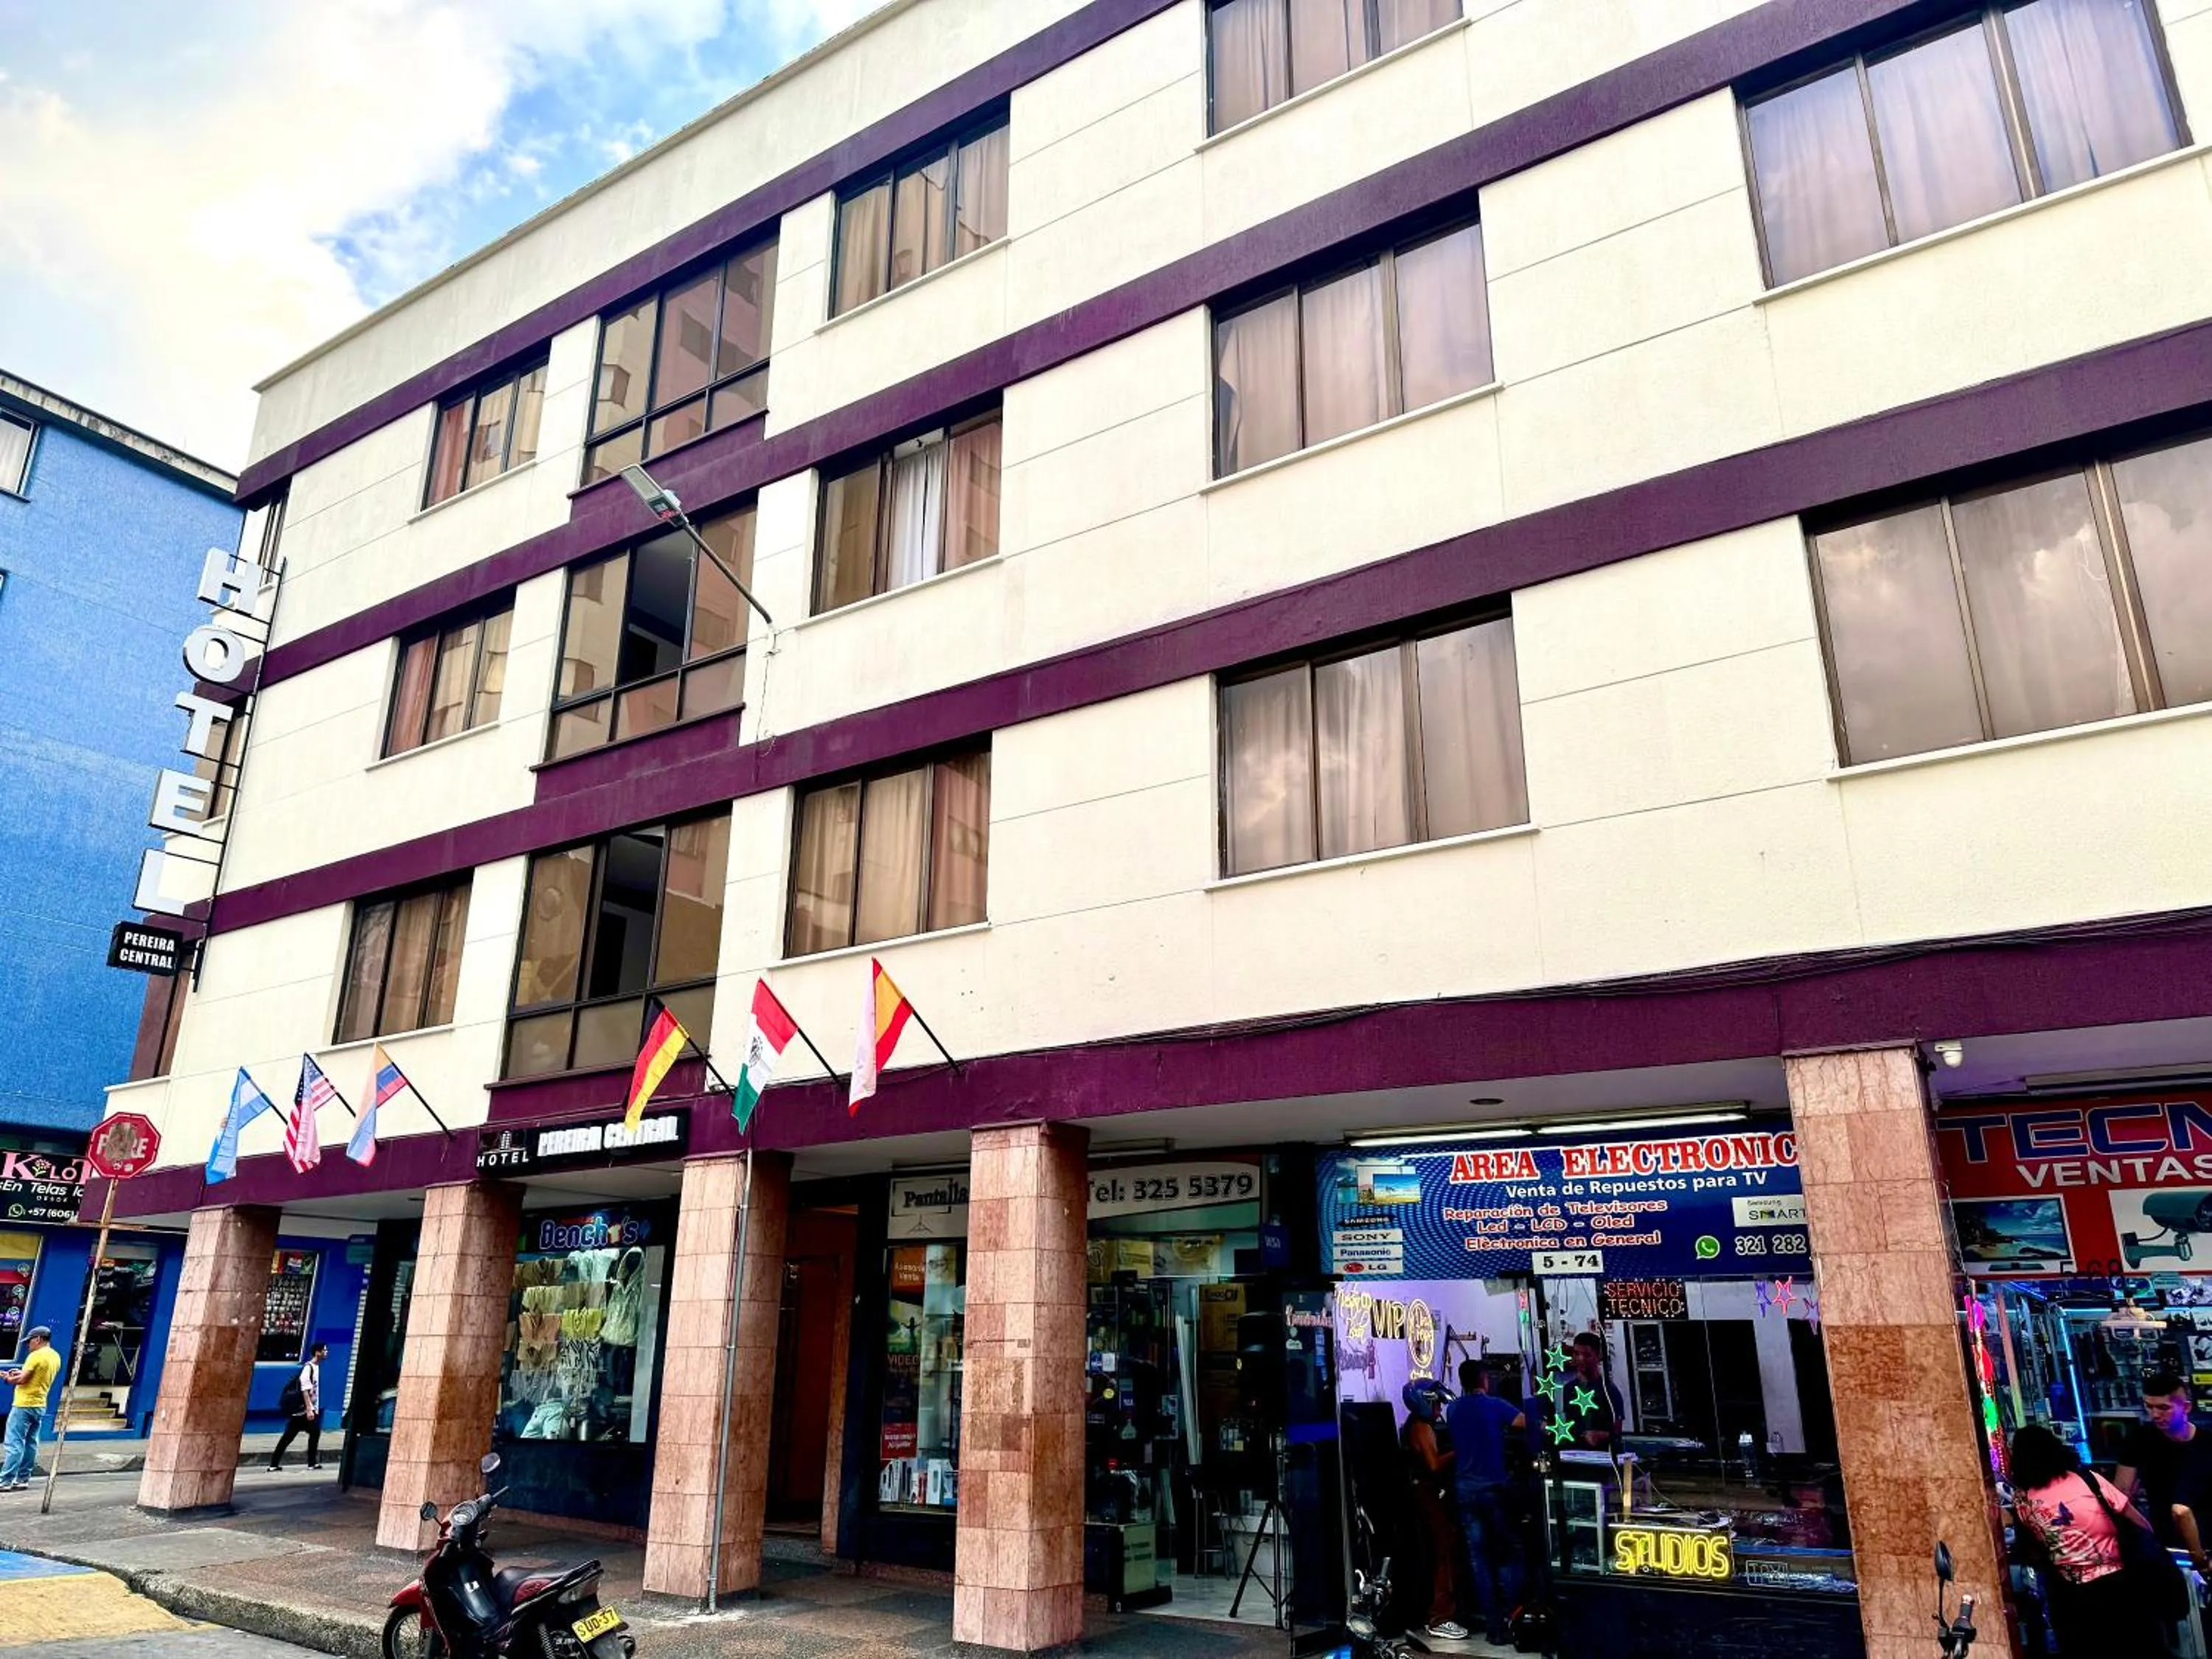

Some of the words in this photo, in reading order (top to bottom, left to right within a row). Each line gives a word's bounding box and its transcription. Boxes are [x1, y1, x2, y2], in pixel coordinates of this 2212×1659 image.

[133, 547, 266, 917] HOTEL
[124, 931, 175, 952] PEREIRA
[119, 948, 173, 970] CENTRAL
[476, 1150, 529, 1167] HOTEL
[1450, 1150, 1540, 1184] AREA
[1562, 1133, 1798, 1178] ELECTRONIC
[2017, 1153, 2212, 1188] VENTAS
[31, 1182, 68, 1196] Telas
[1133, 1179, 1179, 1200] 325
[1188, 1175, 1253, 1197] 5379
[1506, 1184, 1556, 1197] Venta
[1562, 1183, 1584, 1195] de
[1590, 1179, 1686, 1196] Repuestos
[1693, 1175, 1736, 1192] para
[1743, 1172, 1767, 1186] TV
[27, 1208, 46, 1217] +57
[1538, 1203, 1560, 1215] de
[1565, 1199, 1668, 1215] Televisores
[1477, 1220, 1509, 1234] Led
[1531, 1217, 1568, 1231] LCD
[1591, 1214, 1635, 1230] Oled
[1341, 1233, 1391, 1241] SONY
[1564, 1236, 1587, 1248] en
[1591, 1230, 1661, 1247] General
[1735, 1235, 1767, 1255] 321
[1773, 1234, 1807, 1254] 282
[1340, 1247, 1391, 1256] Panasonic
[1543, 1256, 1554, 1268] 5
[1574, 1255, 1599, 1267] 74
[1607, 1281, 1681, 1298] SERVICIO
[1608, 1298, 1683, 1315] TECNICO
[1372, 1299, 1406, 1339] VIP
[1615, 1531, 1730, 1578] STUDIOS
